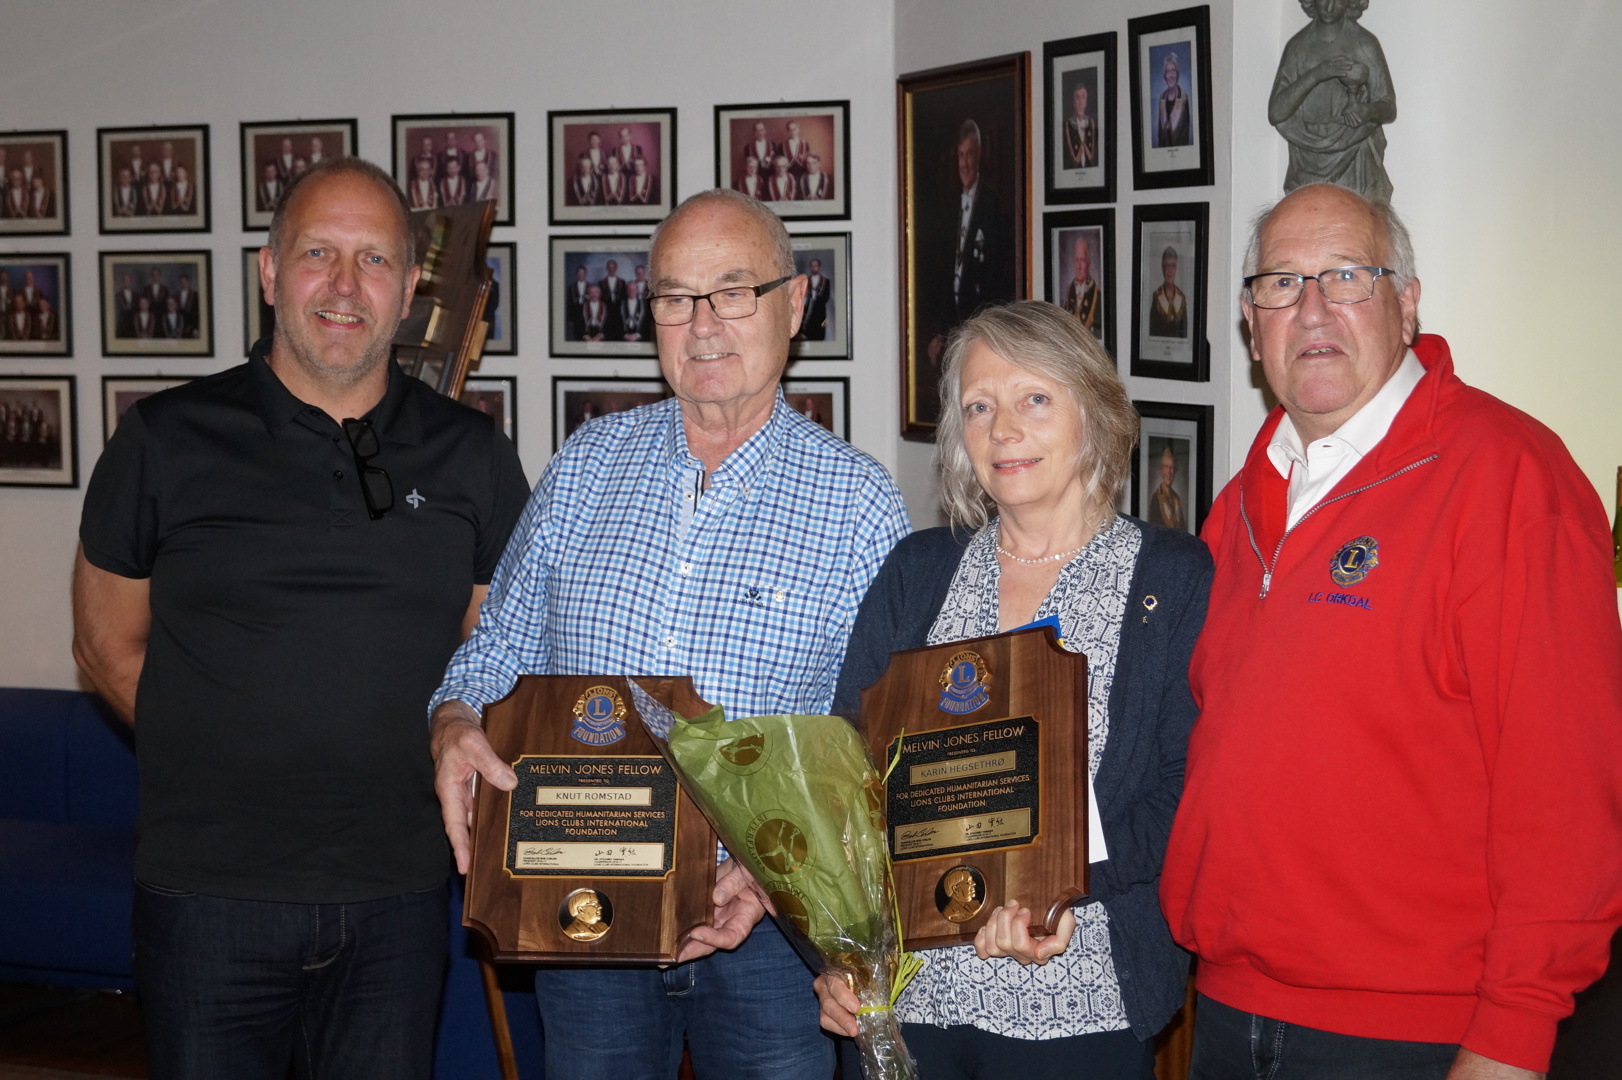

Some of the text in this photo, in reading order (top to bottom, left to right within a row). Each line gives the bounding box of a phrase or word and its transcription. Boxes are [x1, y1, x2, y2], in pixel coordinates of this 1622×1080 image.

[1344, 549, 1359, 568] L
[1307, 592, 1373, 610] LC ORKDAL
[957, 664, 970, 682] L
[593, 699, 606, 716] L
[573, 726, 623, 744] FOUNDATION
[902, 725, 1025, 754] MELVIN JONES FELLOW
[529, 764, 662, 775] MELVIN JONES FELLOW
[920, 757, 1005, 778] KARIN HEGSETHRØ
[556, 792, 632, 800] KNUT ROMSTAD
[896, 774, 1030, 800] FOR DEDICATED HUMANITARIAN SERVICES
[910, 786, 1015, 808] LIONS CLUBS INTERNATIONAL
[937, 799, 986, 813] FOUNDATION
[519, 810, 534, 818] FOR
[535, 810, 574, 818] DEDICATED
[633, 811, 665, 819] SERVICES
[535, 819, 649, 828] LIONS CLUBS INTERNATIONAL
[564, 828, 618, 836] FOUNDATION
[746, 813, 767, 873] INTERFLORA
